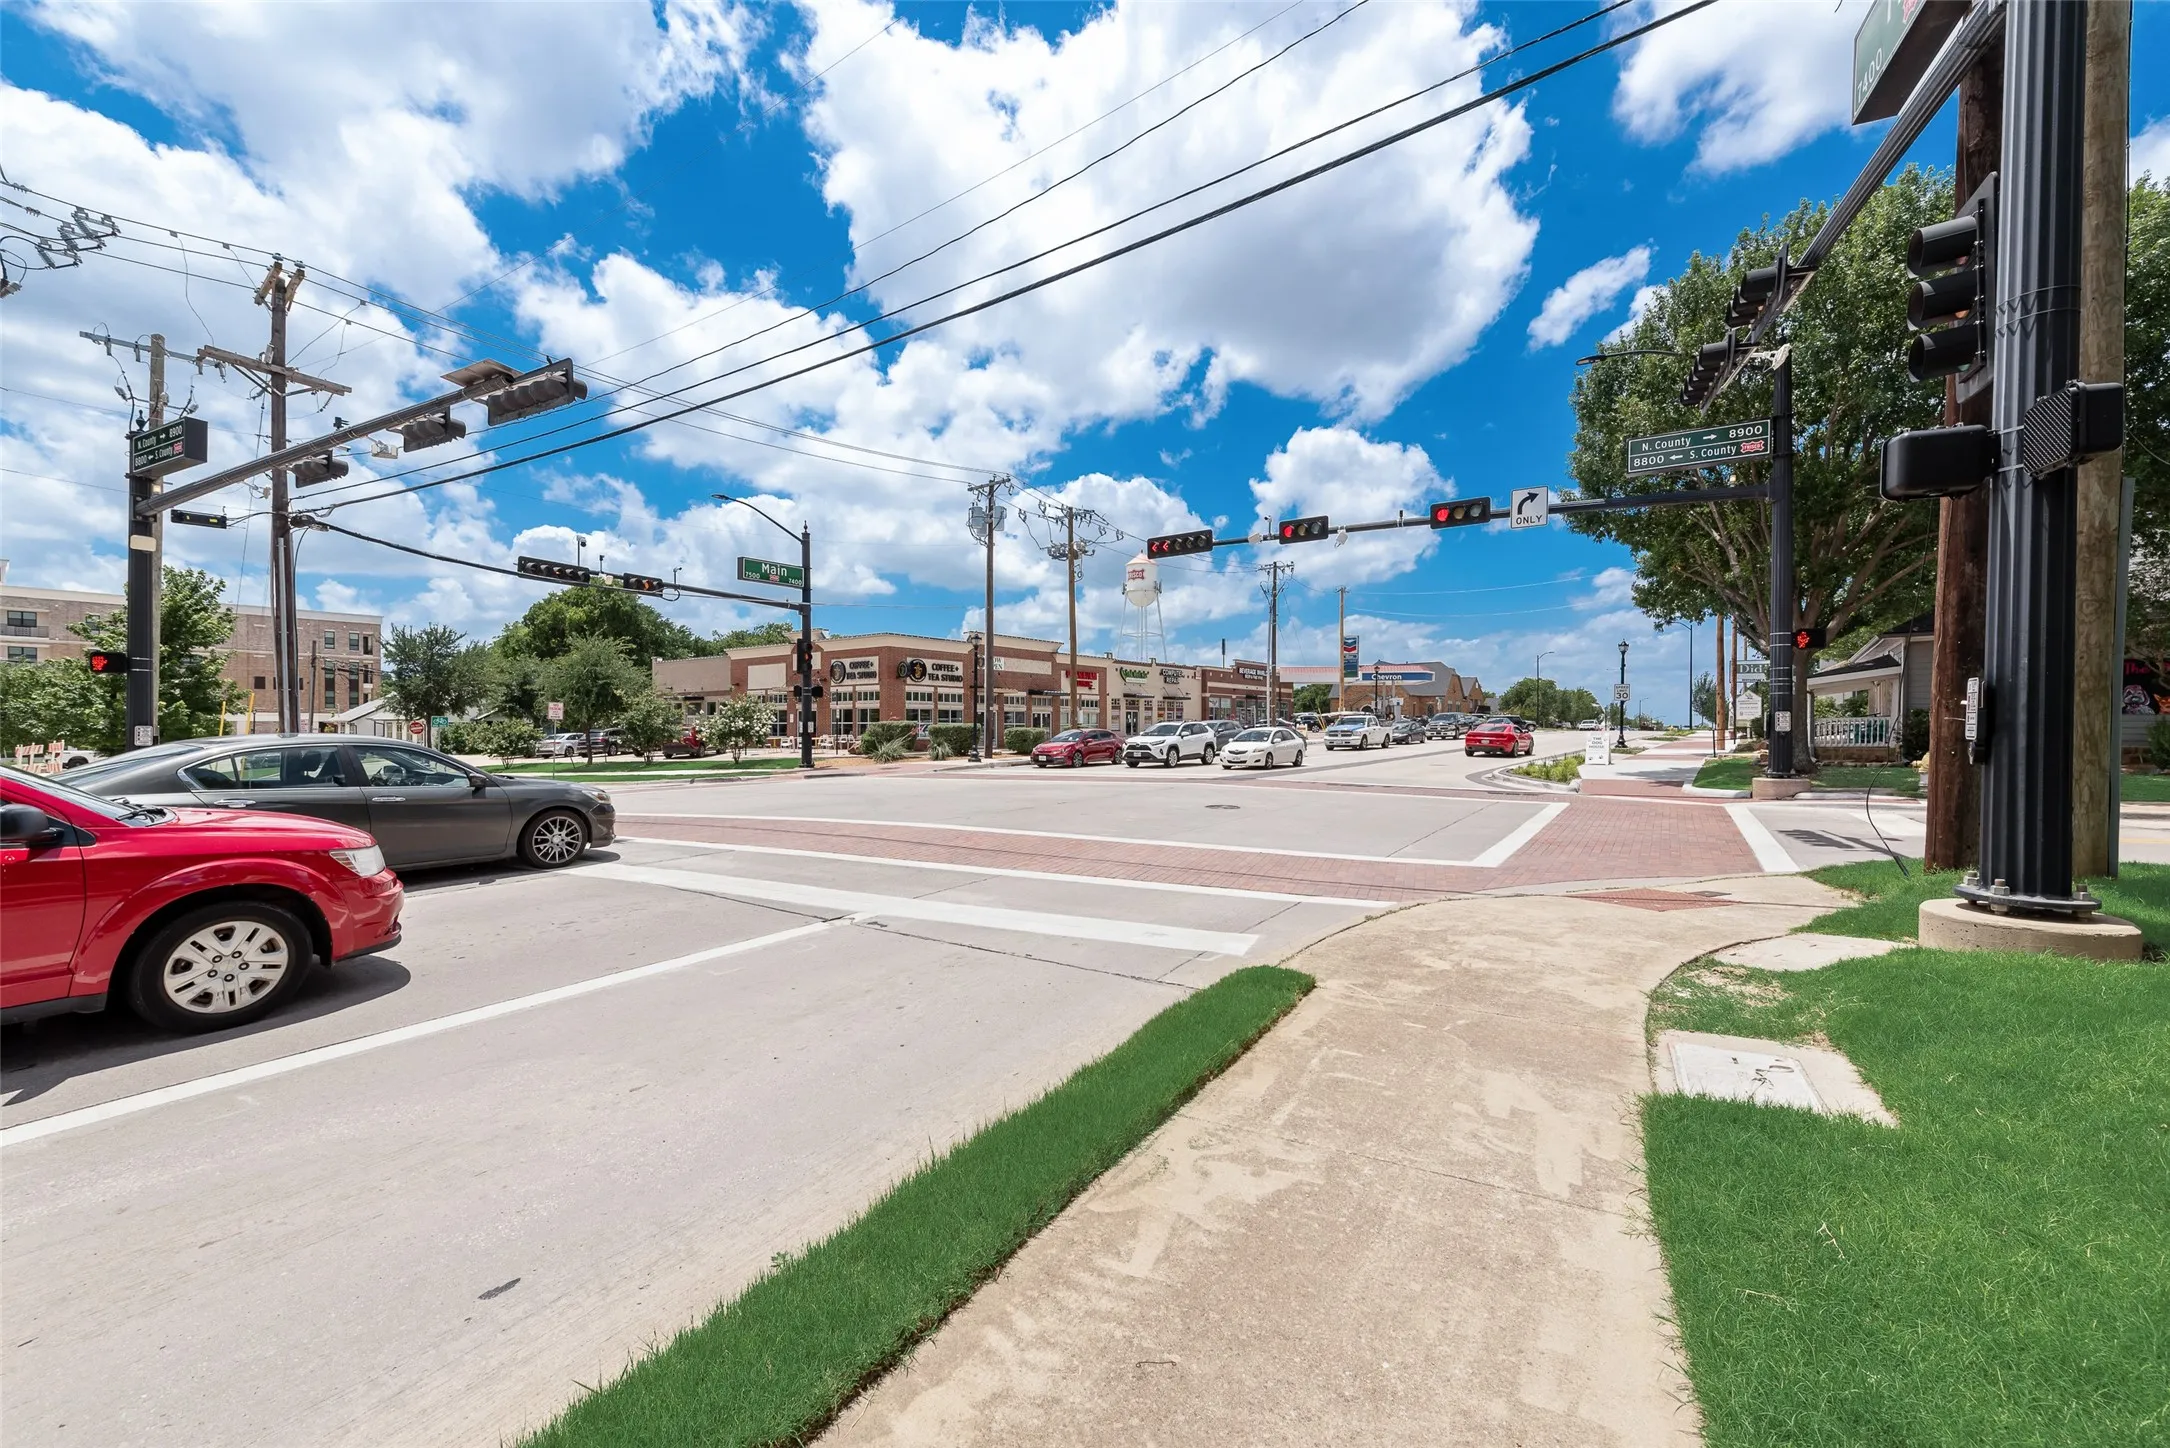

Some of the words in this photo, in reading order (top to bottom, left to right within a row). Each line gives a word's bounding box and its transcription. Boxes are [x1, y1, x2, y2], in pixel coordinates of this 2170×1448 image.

[1857, 48, 1882, 103] 7400
[142, 436, 156, 448] County
[169, 425, 183, 438] 8900
[1642, 443, 1652, 451] N.
[1655, 437, 1692, 450] County
[1729, 425, 1763, 438] 8900
[1743, 442, 1762, 450] FRISCO
[135, 454, 147, 467] 8800
[159, 446, 173, 458] County
[1633, 455, 1665, 467] 8800
[1689, 450, 1699, 459] S.
[1701, 445, 1737, 457] County
[1516, 515, 1542, 525] ONLY
[745, 571, 760, 579] 7500
[761, 563, 787, 576] Main
[846, 671, 857, 680] TEA
[857, 671, 877, 680] STUDIO
[928, 673, 940, 682] TEA
[941, 674, 963, 683] STUDIO
